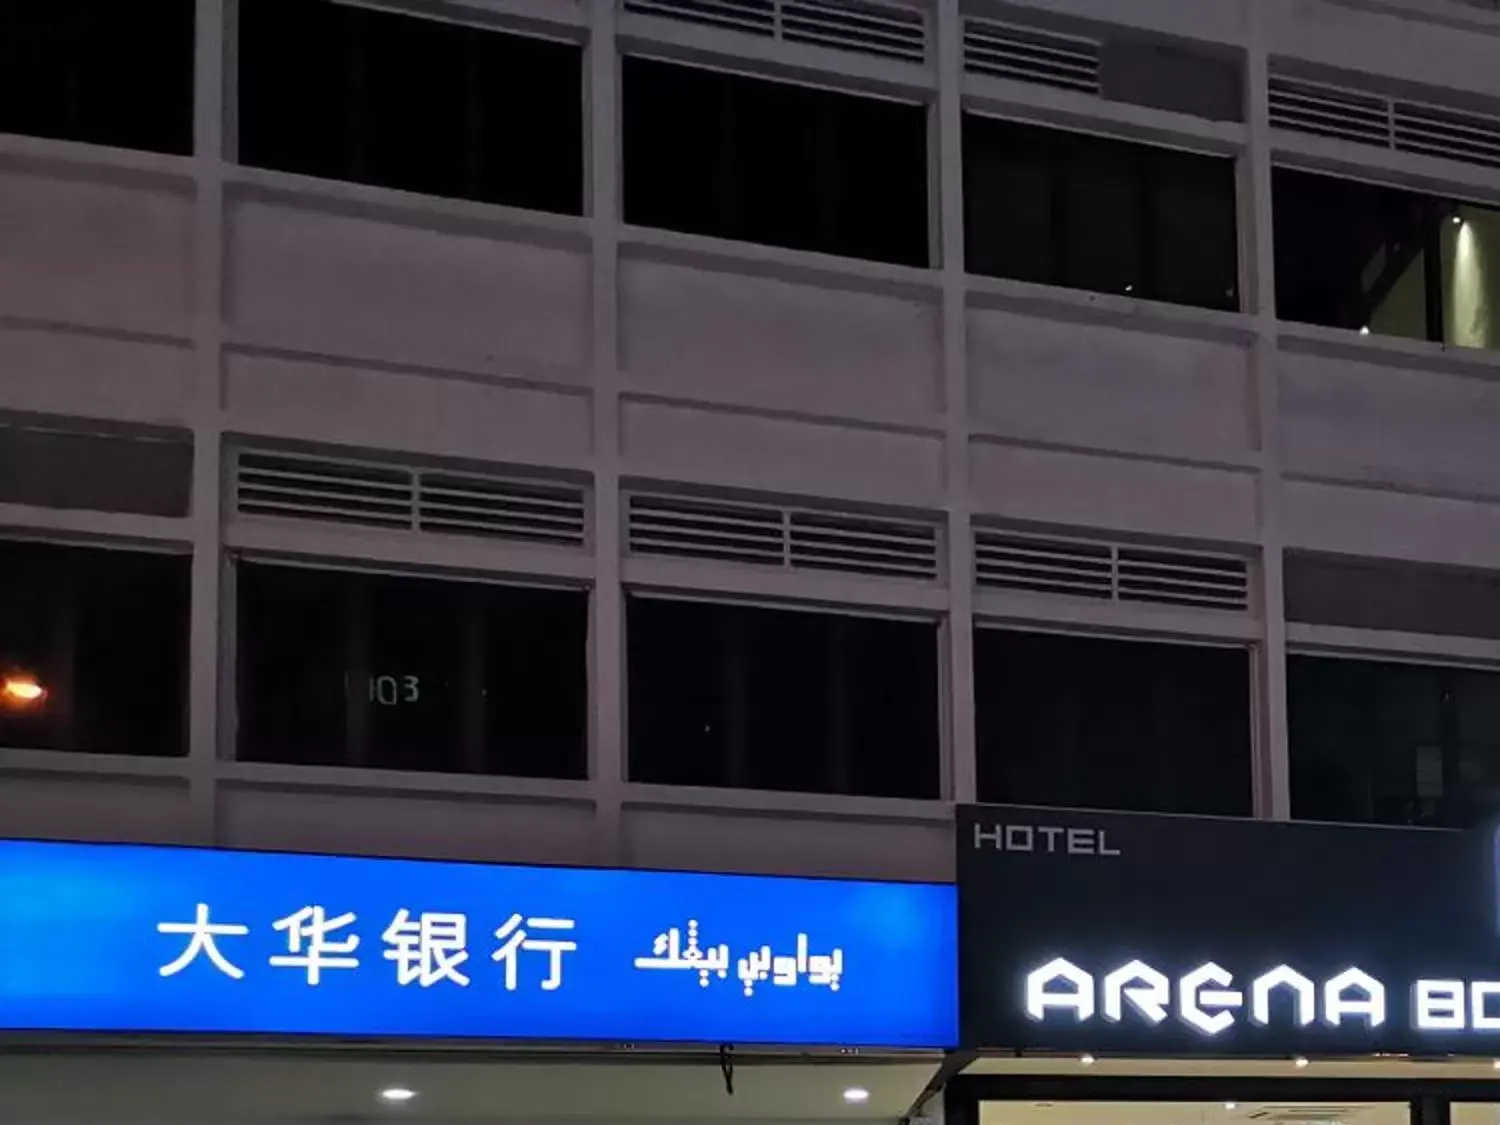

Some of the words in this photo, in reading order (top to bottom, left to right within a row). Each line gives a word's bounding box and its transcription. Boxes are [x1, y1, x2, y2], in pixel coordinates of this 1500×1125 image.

[974, 824, 1121, 856] HOTEL
[157, 903, 577, 990] 大华银行
[1025, 957, 1386, 1035] ARENA
